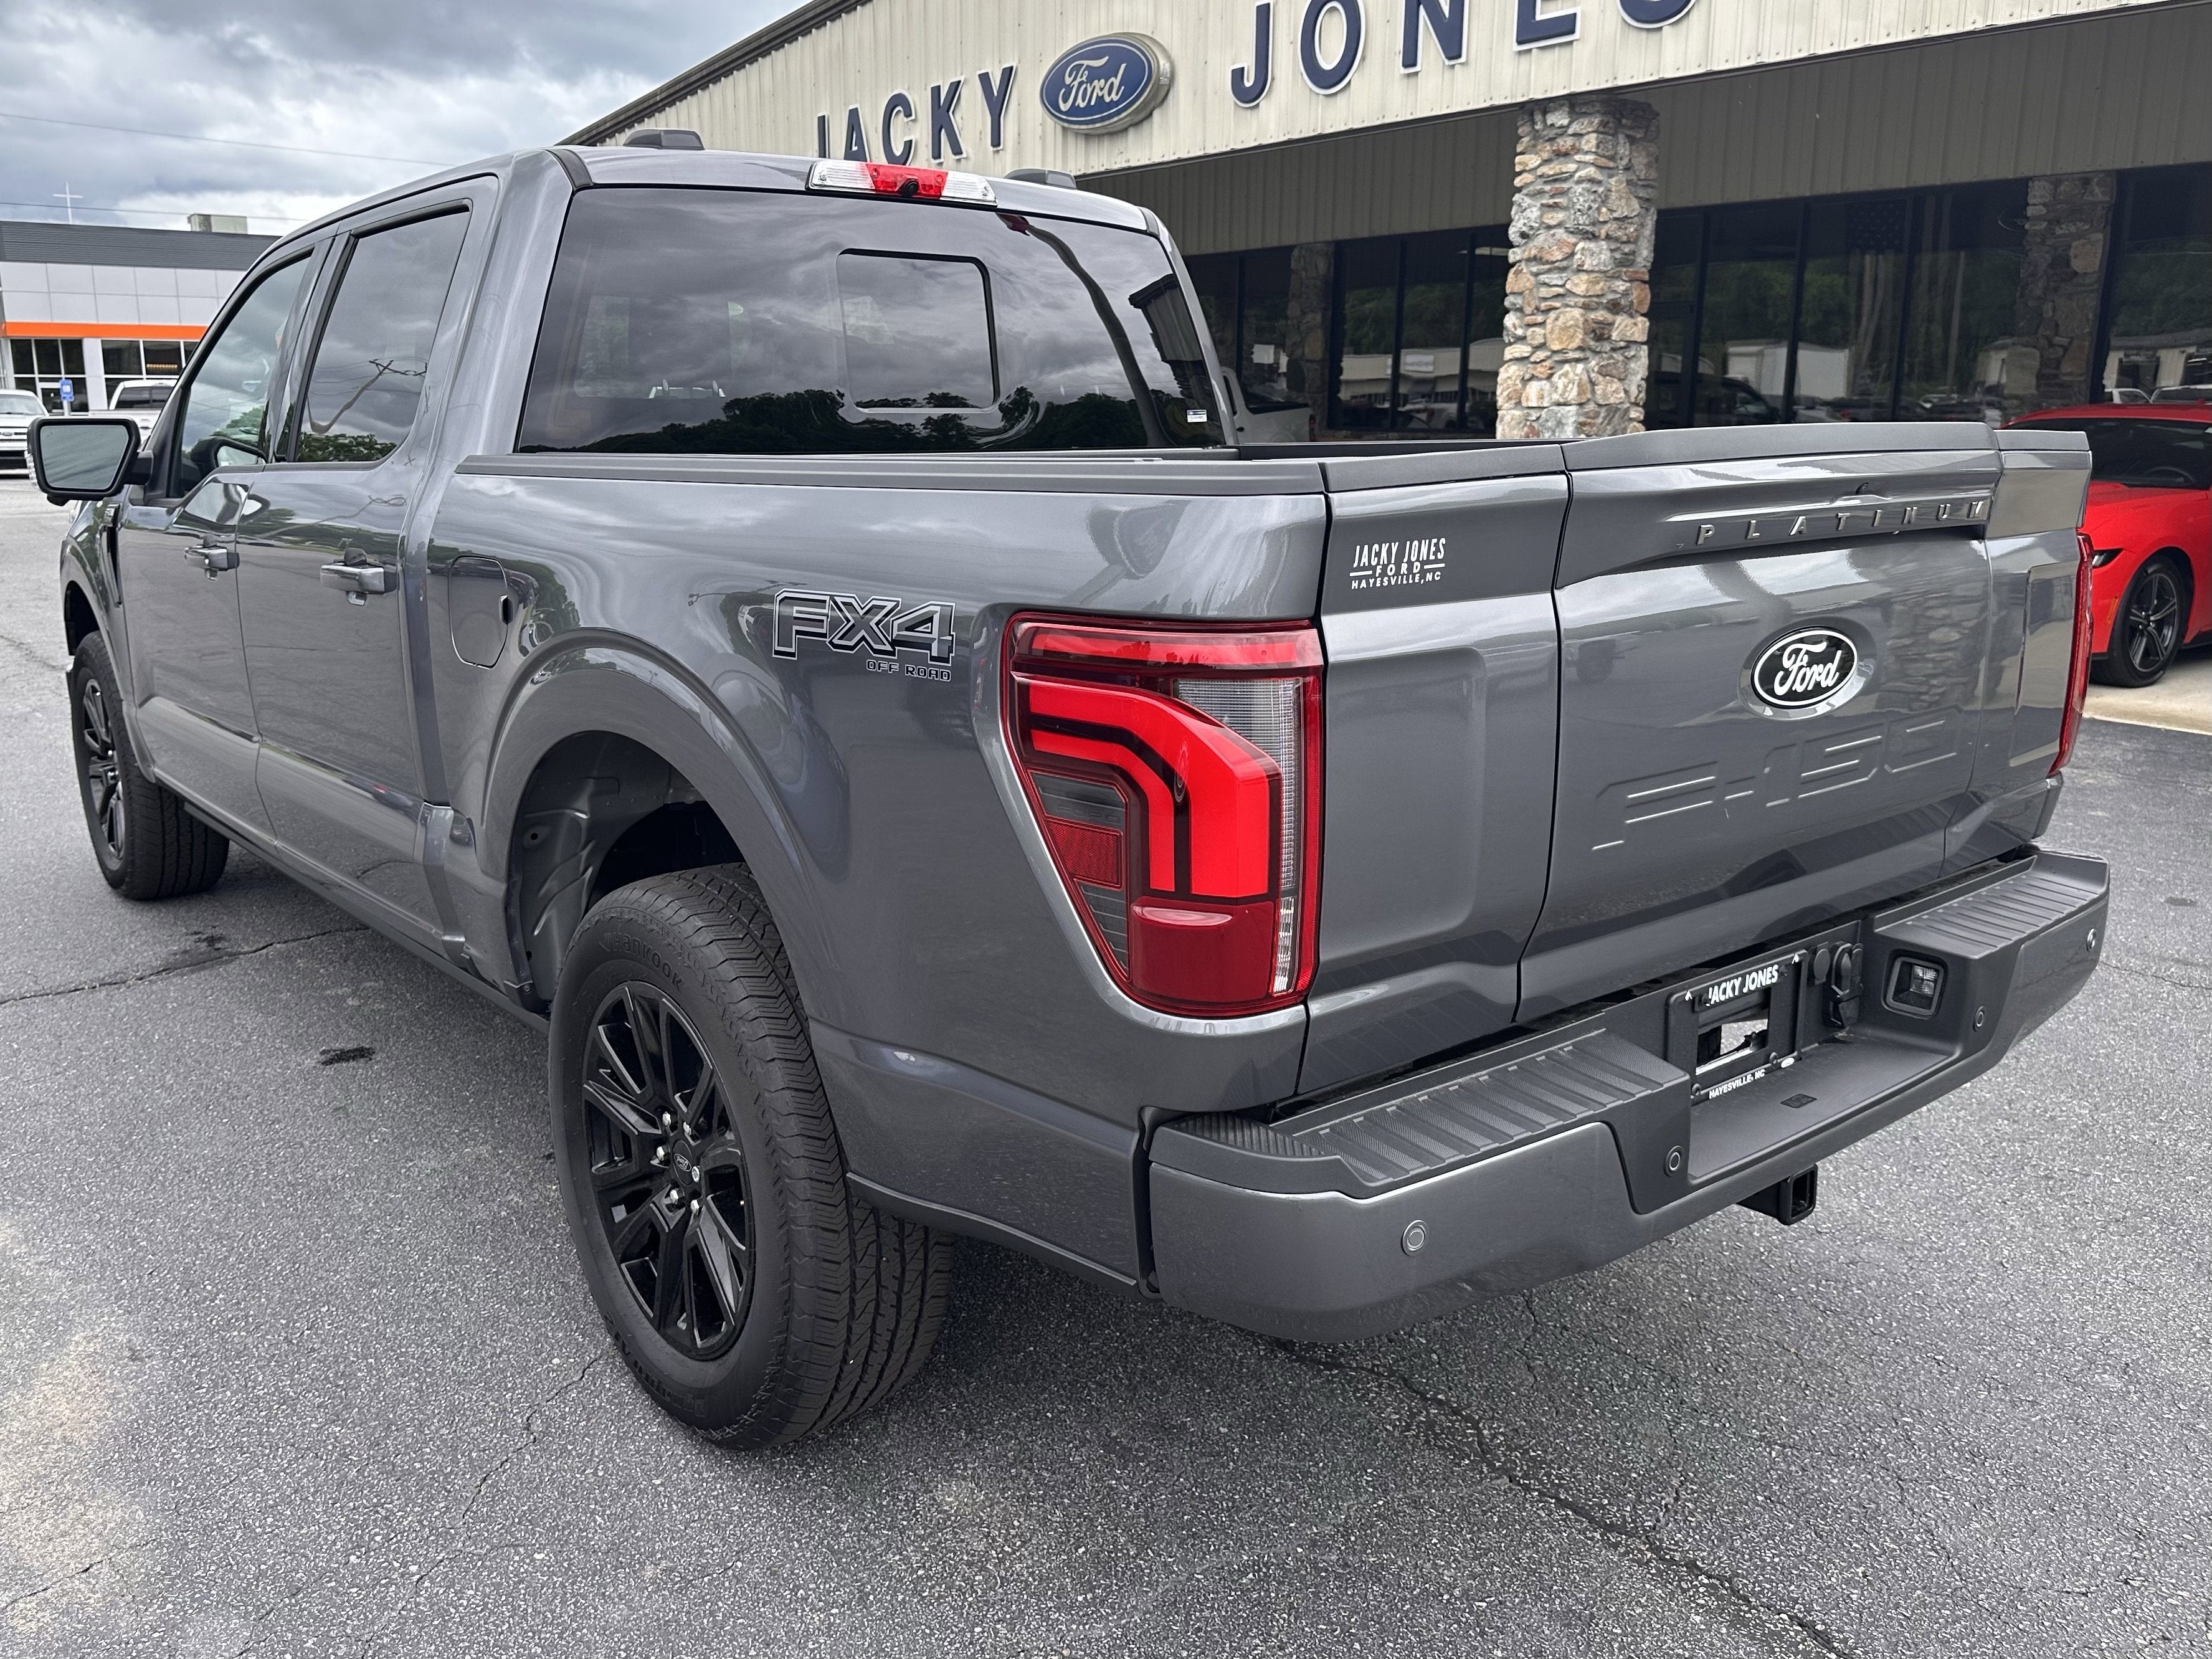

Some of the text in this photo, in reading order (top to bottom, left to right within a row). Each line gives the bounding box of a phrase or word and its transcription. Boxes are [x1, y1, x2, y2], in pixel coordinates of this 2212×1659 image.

[1230, 0, 1696, 107] JON
[1058, 55, 1127, 112] Ford
[817, 64, 1017, 165] JACKY
[1695, 500, 1984, 546] PLATINUM
[1352, 537, 1446, 568] JACKY JONES
[1375, 561, 1421, 578] FORD
[772, 587, 956, 667] FX4
[866, 658, 952, 682] OFF ROAD
[1773, 641, 1843, 696] Ford
[1706, 964, 1779, 1007] JACKY JONES
[1709, 1068, 1766, 1100] HAYESVILLE, NC
